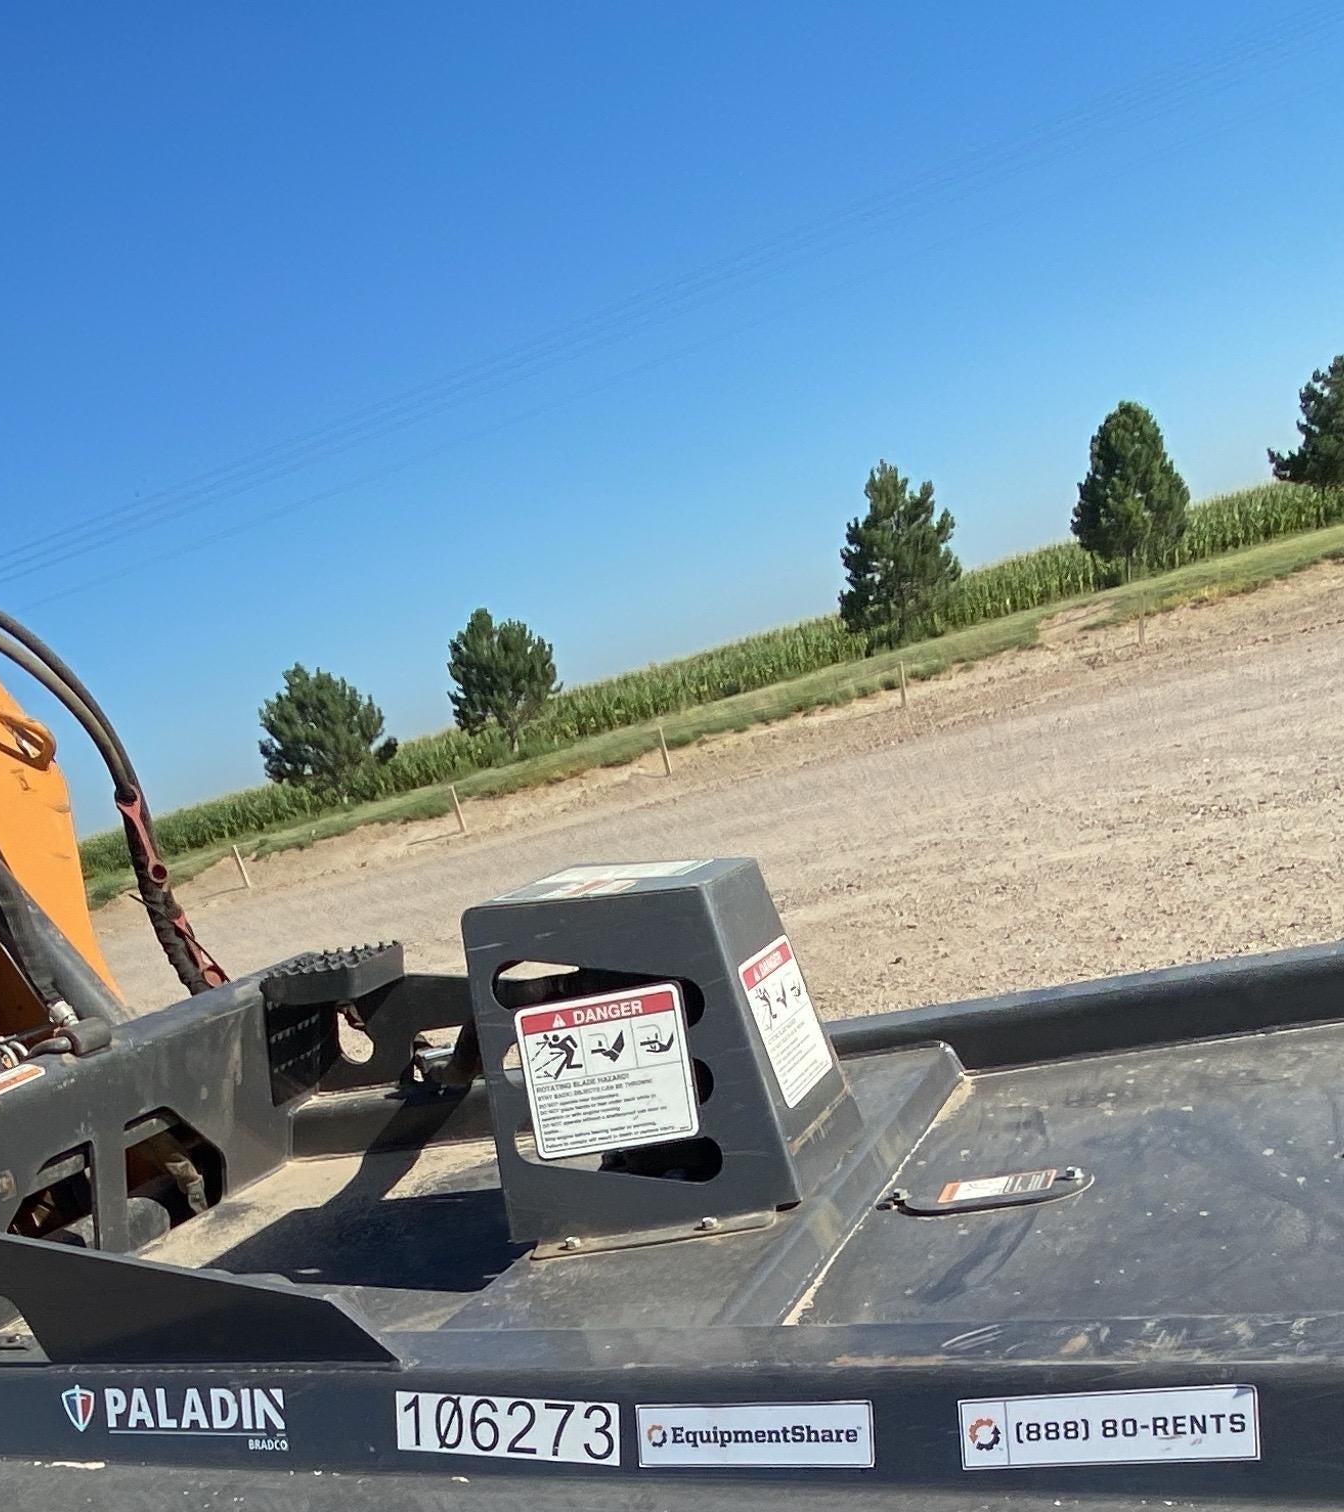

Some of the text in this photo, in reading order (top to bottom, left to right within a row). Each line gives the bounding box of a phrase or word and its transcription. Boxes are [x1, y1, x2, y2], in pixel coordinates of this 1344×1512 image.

[573, 1000, 643, 1025] DANGER
[104, 1387, 286, 1430] PALADIN
[402, 1393, 616, 1460] 106273
[670, 1425, 860, 1447] EquipmentShare
[1015, 1413, 1247, 1445] (888) 80-RENTS
[248, 1438, 289, 1451] BRADCO
